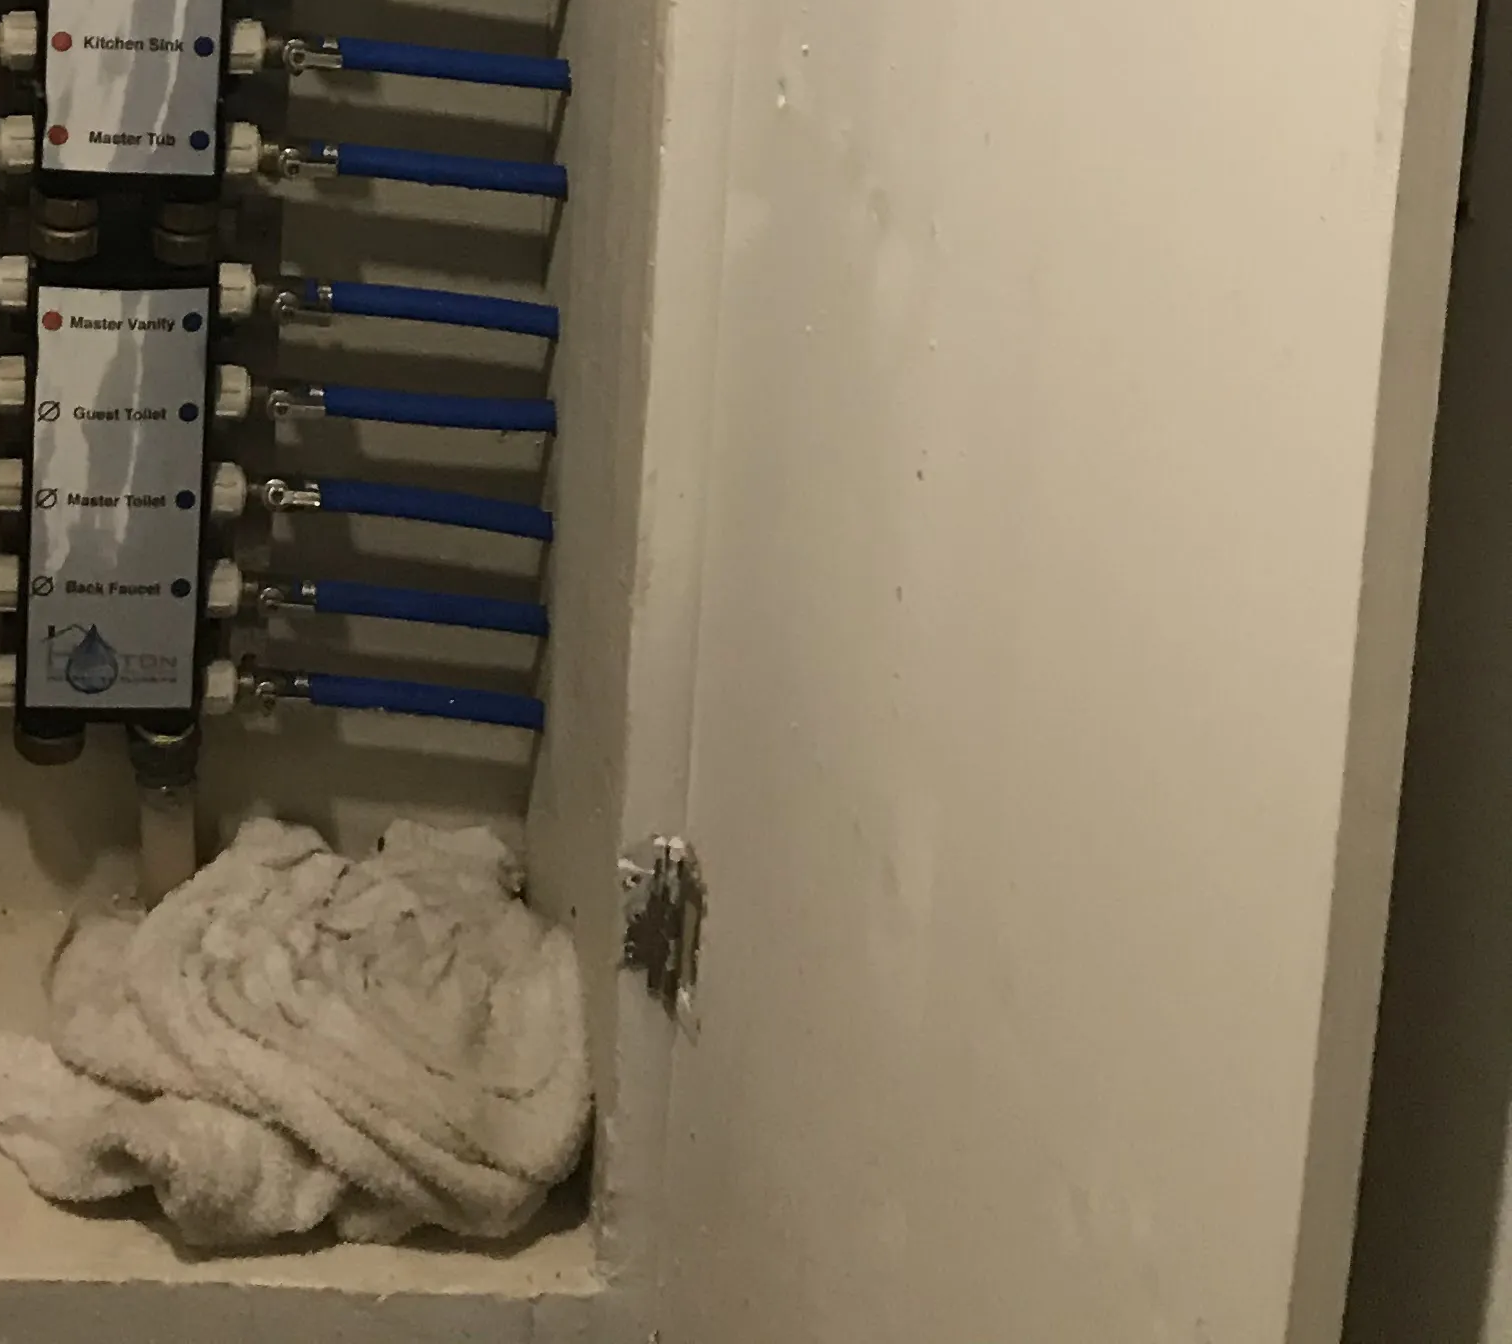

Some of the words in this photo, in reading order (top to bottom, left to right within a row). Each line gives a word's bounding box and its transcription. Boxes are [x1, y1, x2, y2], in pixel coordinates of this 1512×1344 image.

[84, 36, 144, 51] Kitchen
[149, 37, 184, 52] Sink
[89, 131, 141, 145] Master
[147, 132, 176, 146] Tub
[70, 316, 123, 331] Master
[128, 317, 175, 332] Vanity
[73, 406, 119, 421] Guest
[124, 407, 167, 421] Toilet
[67, 493, 120, 507] Master
[125, 494, 165, 507] Toilet
[66, 580, 103, 595] Back
[109, 582, 161, 596] Faucet
